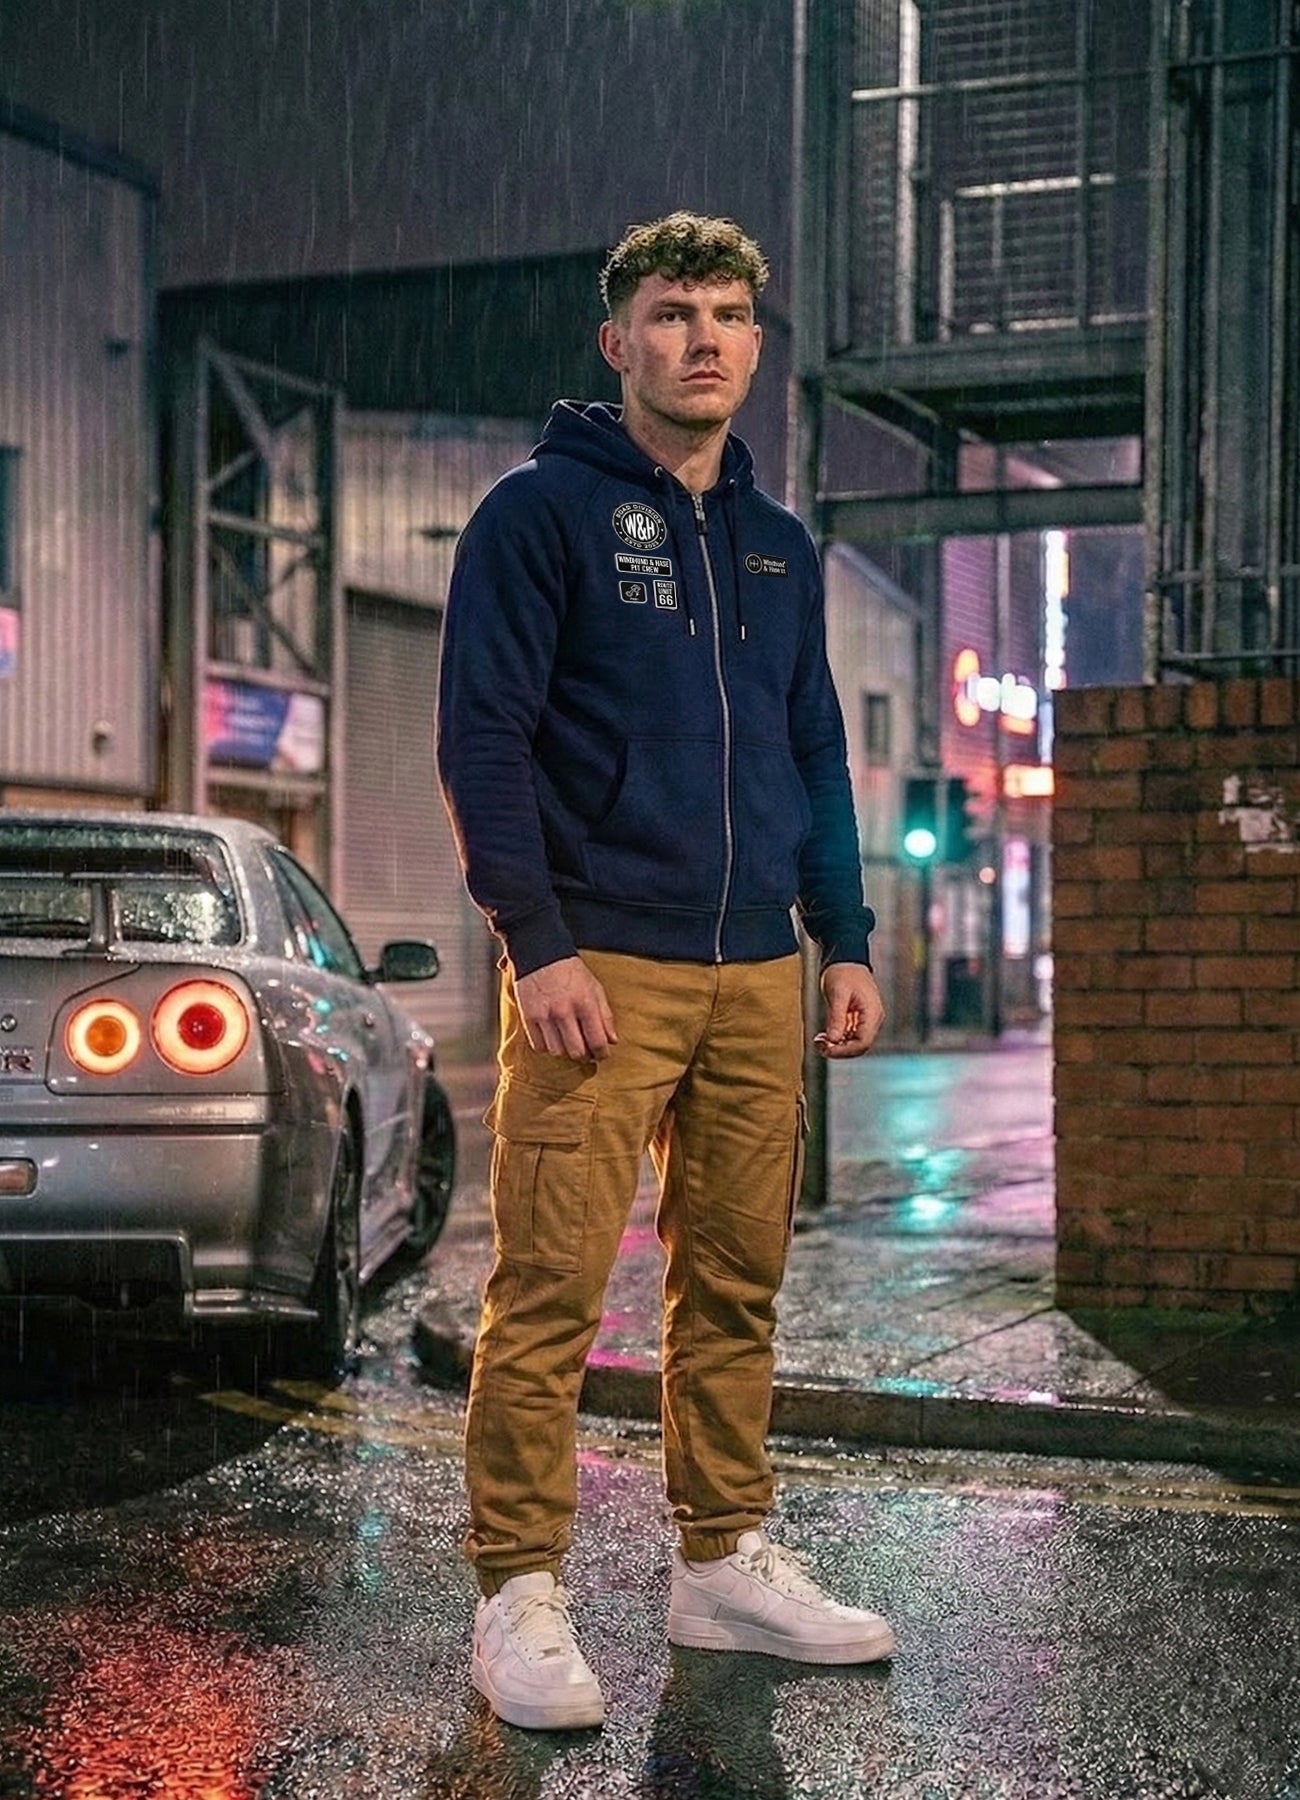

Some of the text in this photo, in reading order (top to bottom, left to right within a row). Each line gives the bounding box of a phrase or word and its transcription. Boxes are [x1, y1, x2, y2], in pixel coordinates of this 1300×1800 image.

[633, 504, 662, 524] DIVISION
[625, 513, 655, 541] W&H
[659, 595, 674, 606] 66
